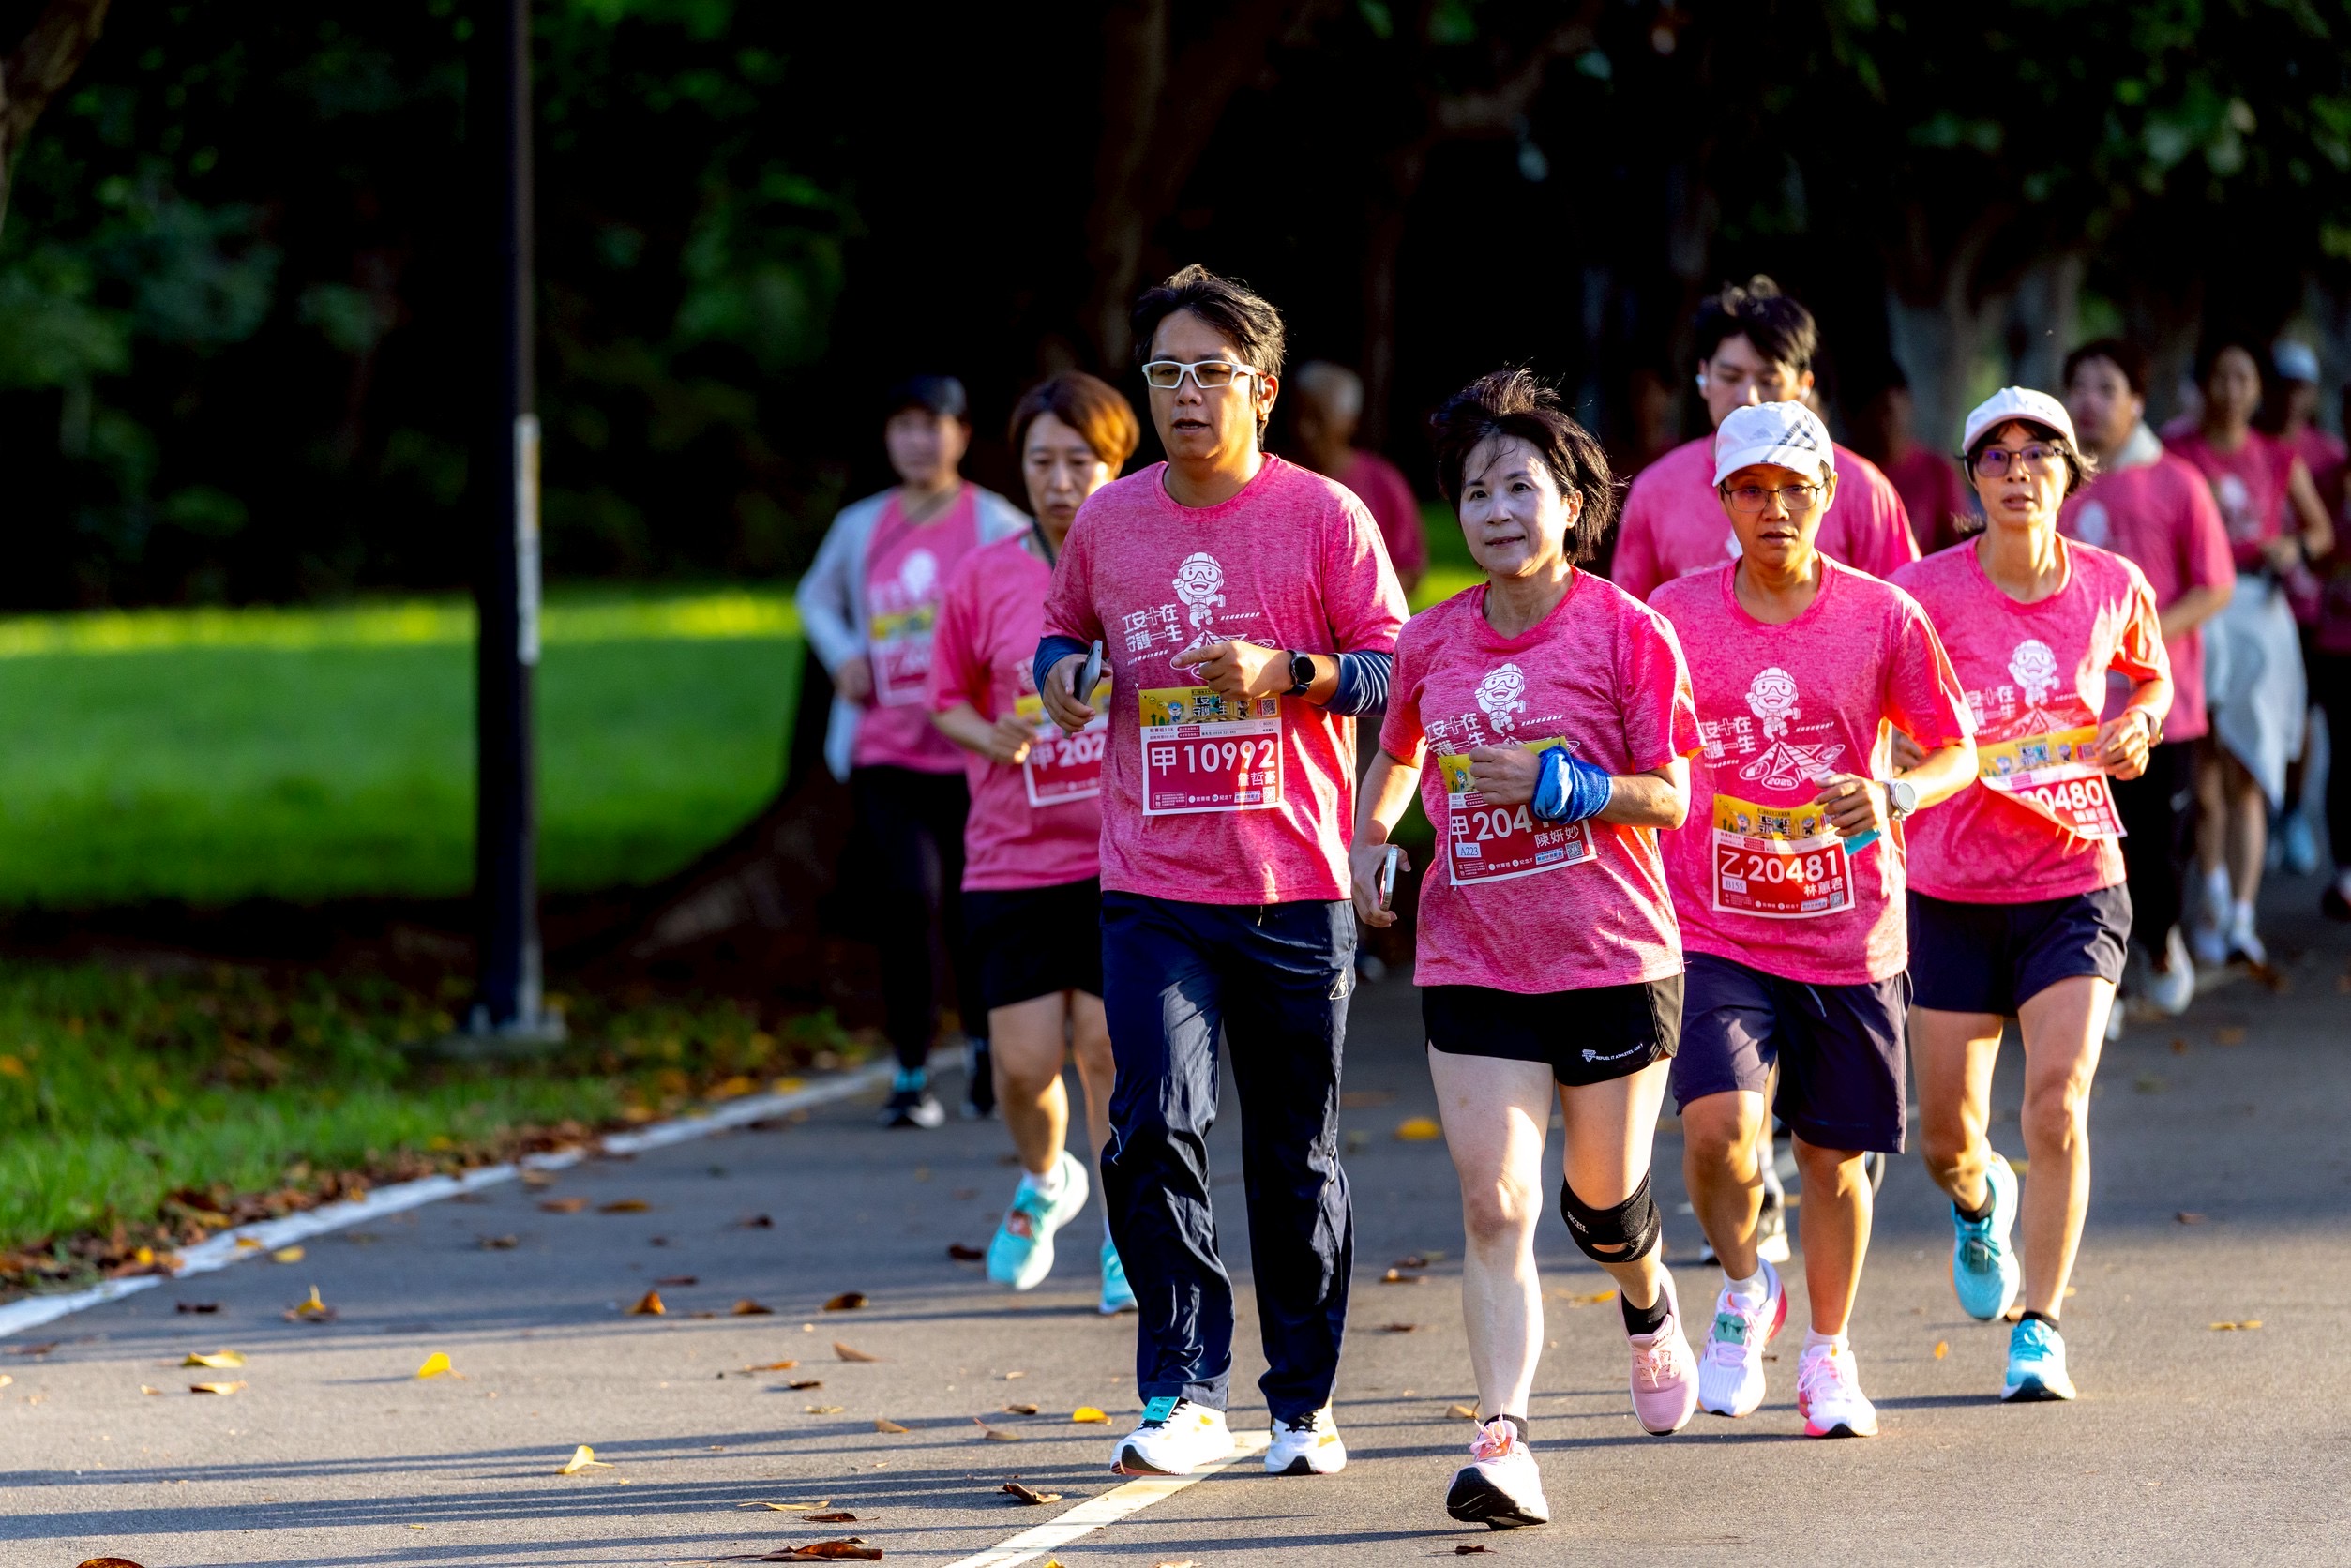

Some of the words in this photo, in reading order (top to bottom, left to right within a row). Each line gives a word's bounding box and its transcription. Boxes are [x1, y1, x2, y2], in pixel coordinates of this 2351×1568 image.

[1126, 624, 1183, 652] 守護一生
[1767, 777, 1792, 786] 2025
[1534, 825, 1579, 849] 陳妍妙
[1460, 846, 1479, 856] A223
[1725, 882, 1744, 891] B155
